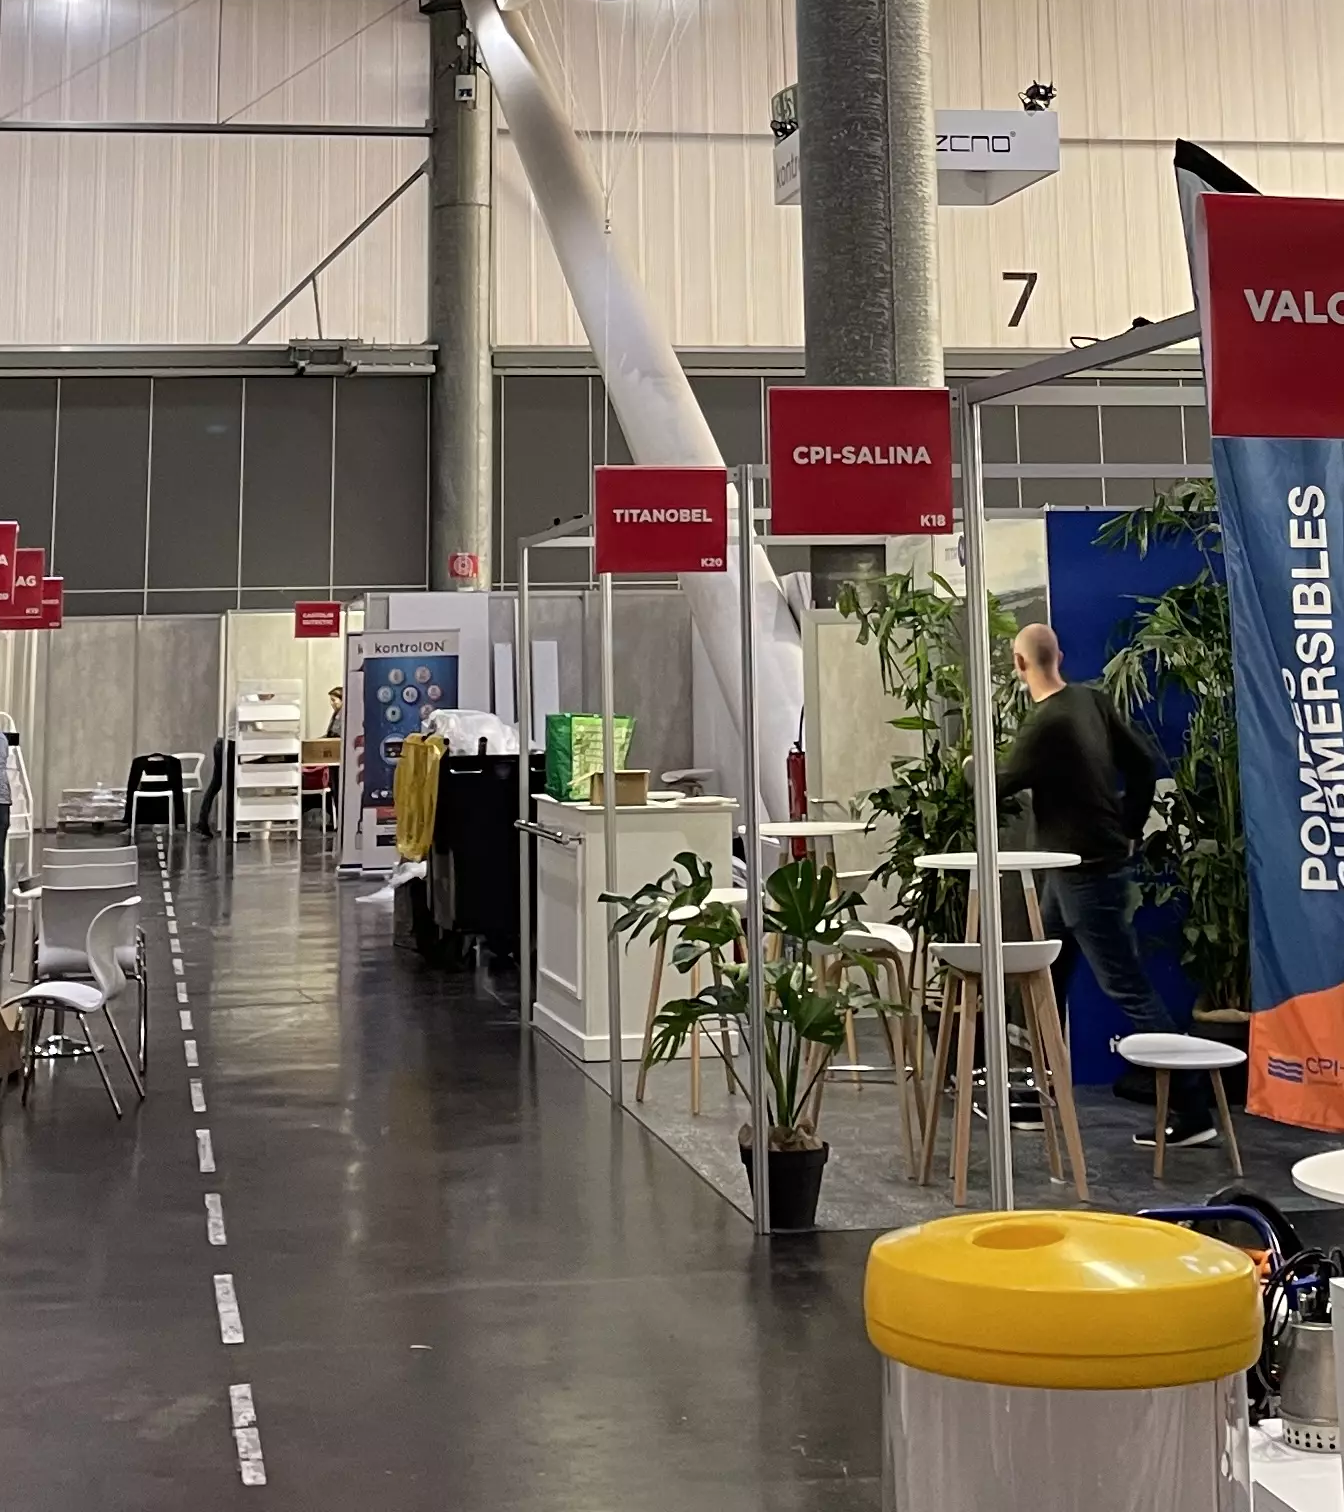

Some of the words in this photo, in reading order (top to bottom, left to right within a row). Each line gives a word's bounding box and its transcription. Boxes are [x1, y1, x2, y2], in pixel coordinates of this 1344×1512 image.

[1002, 272, 1038, 327] 7
[793, 446, 932, 465] CPI-SALINA
[612, 508, 713, 524] TITANOBEL
[920, 514, 947, 528] K18
[700, 557, 724, 568] K20
[15, 575, 37, 587] AG
